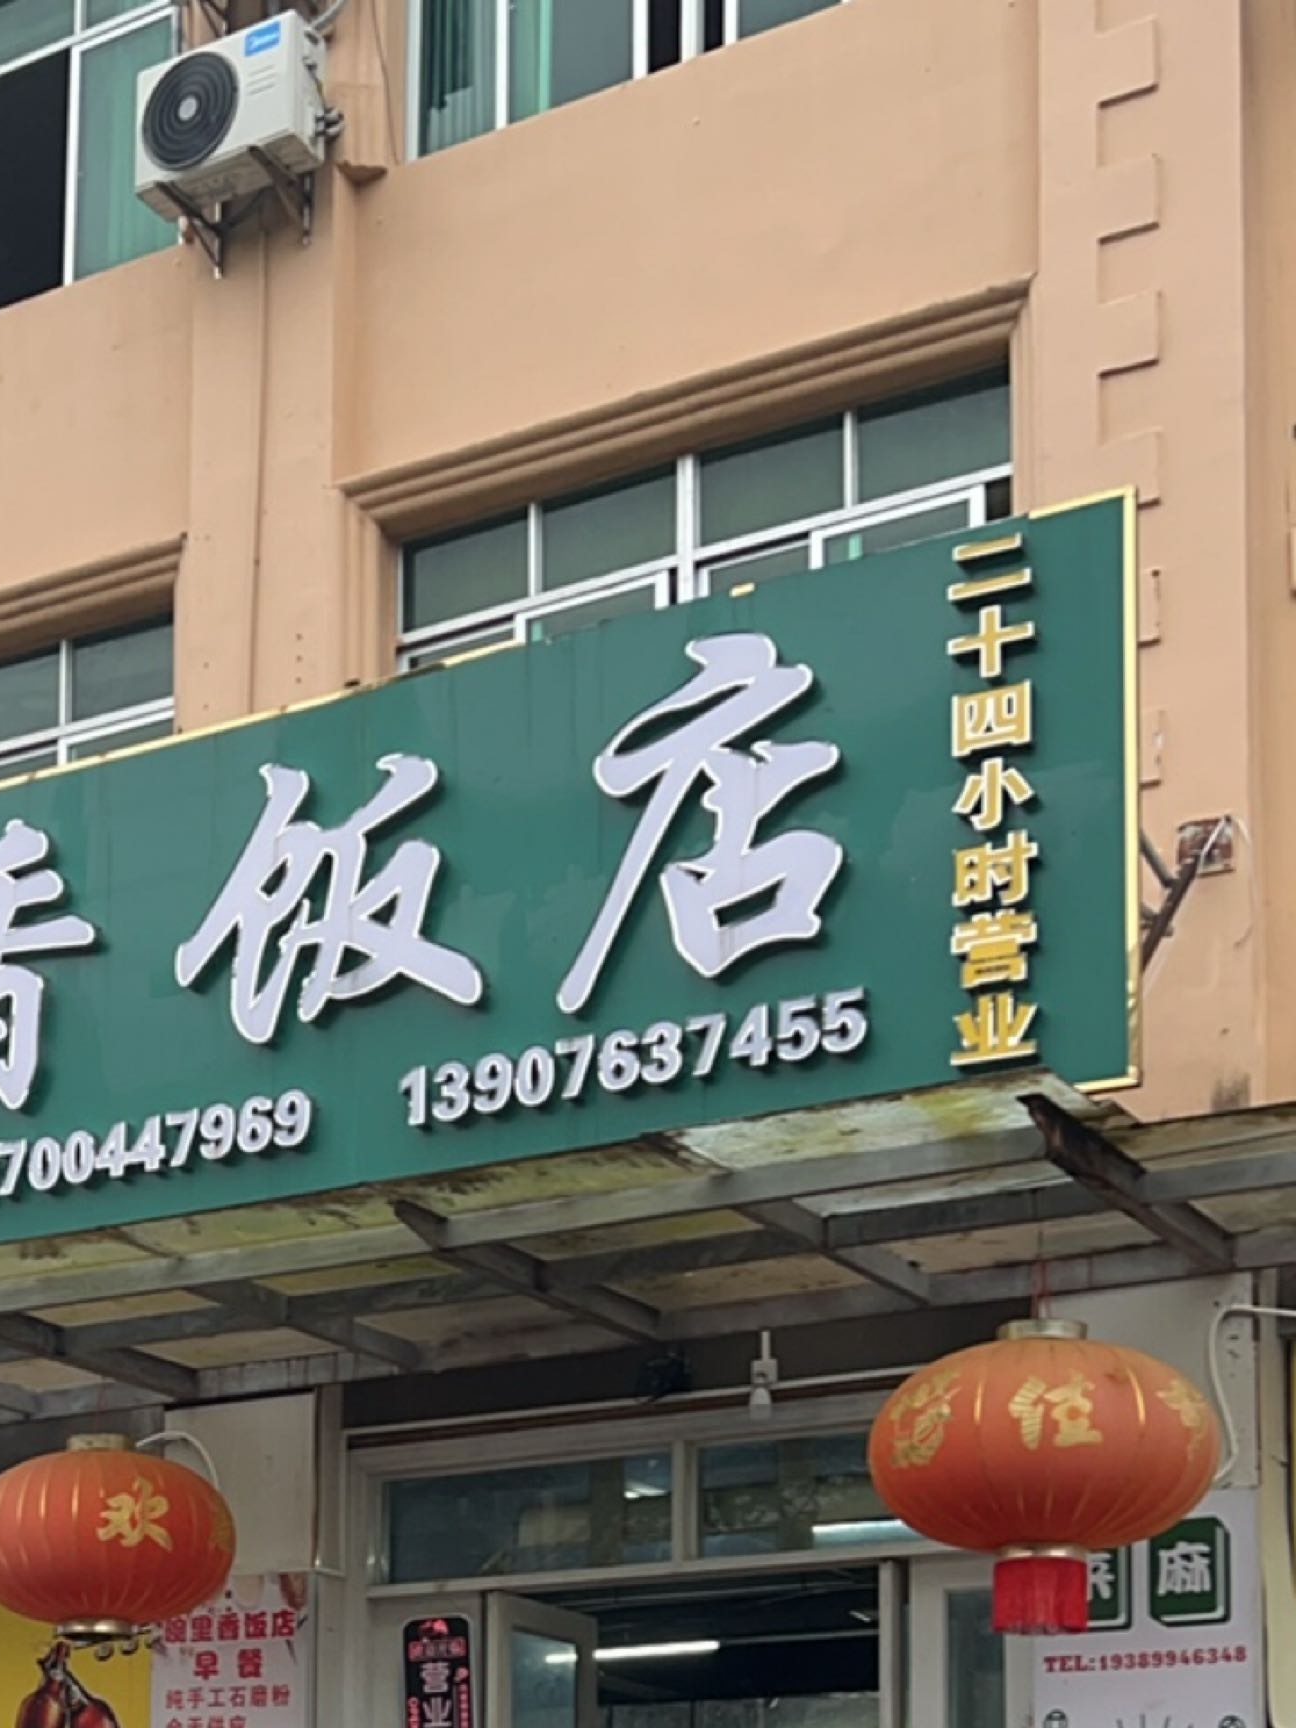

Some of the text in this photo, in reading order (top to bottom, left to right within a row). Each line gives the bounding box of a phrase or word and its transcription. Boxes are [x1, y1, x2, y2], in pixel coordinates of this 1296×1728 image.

[947, 532, 1038, 1067] 二十四小时营业
[398, 987, 868, 1126] 13907637455
[164, 1608, 297, 1643] 碗里香饭店
[165, 1684, 291, 1711] 纯手工石磨粉
